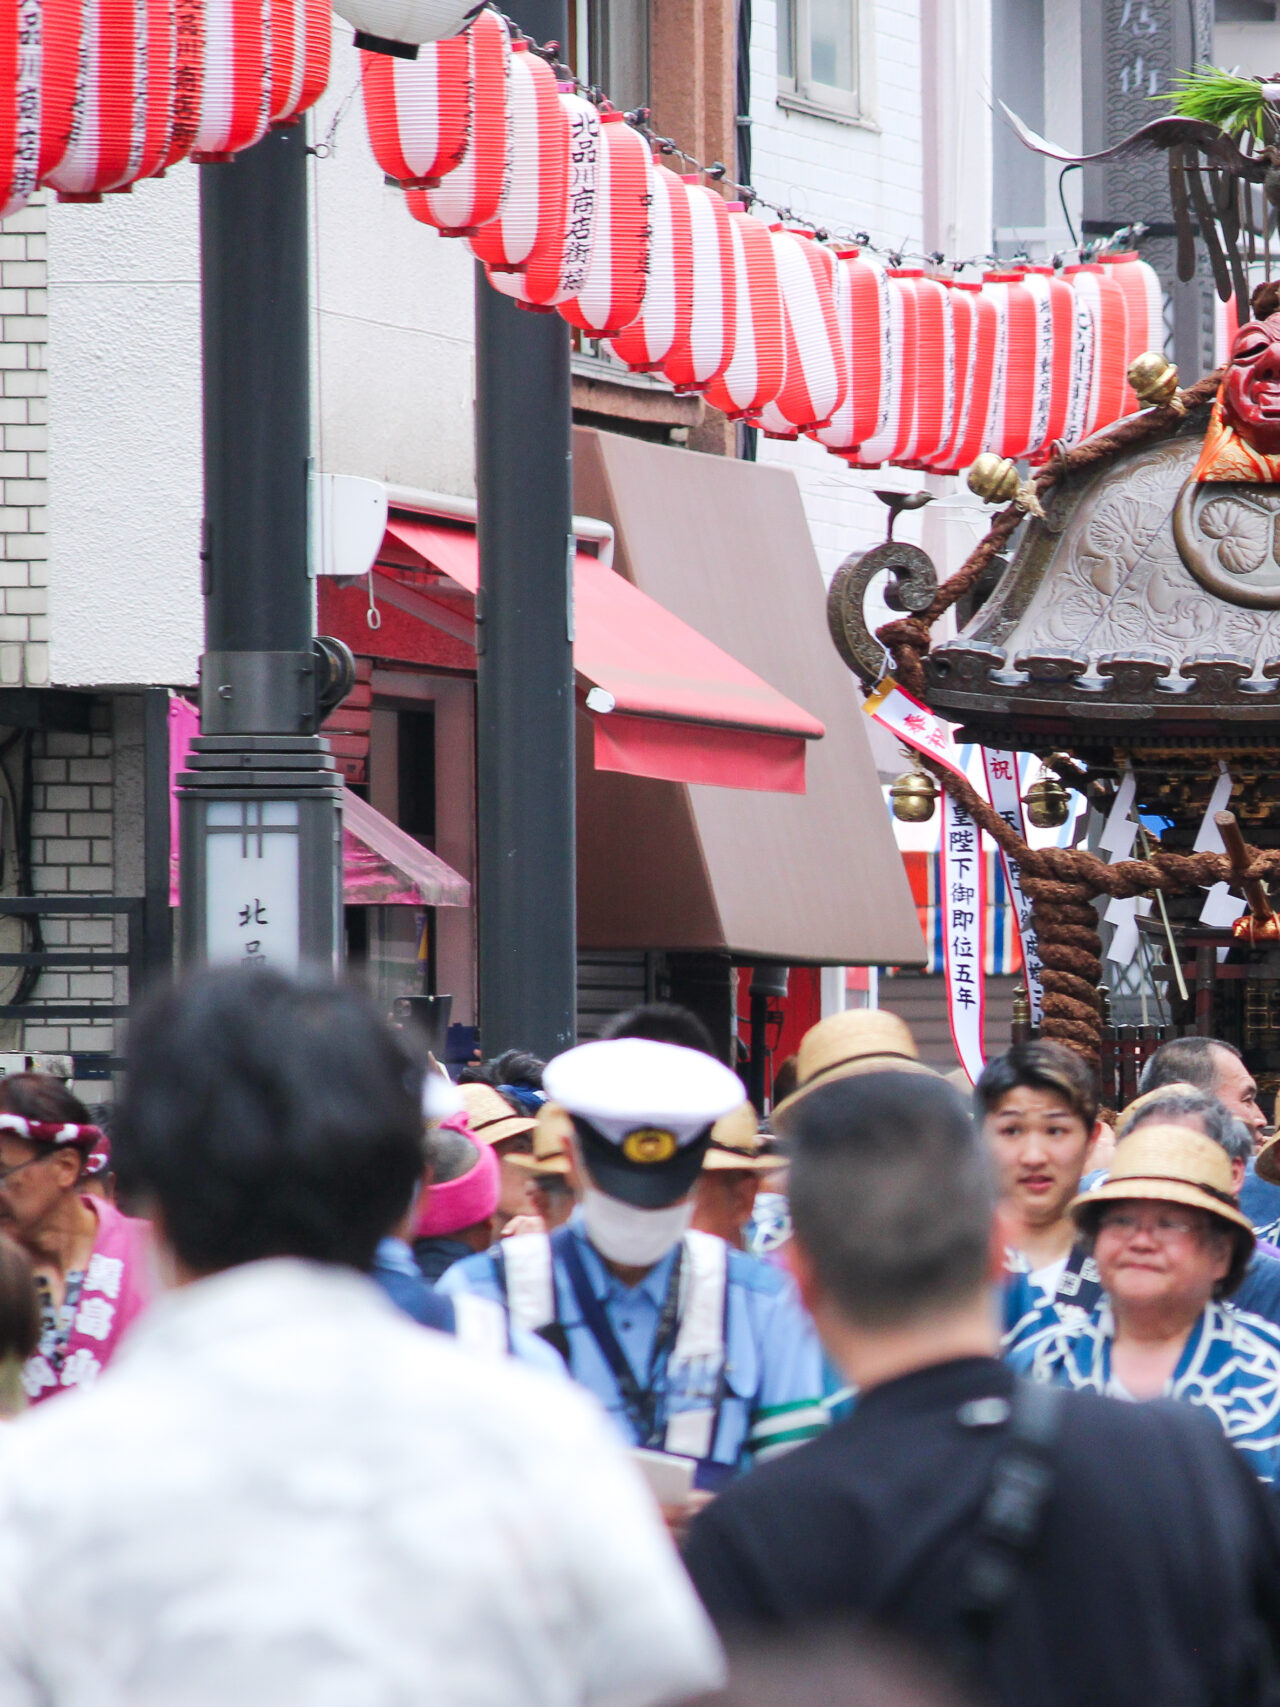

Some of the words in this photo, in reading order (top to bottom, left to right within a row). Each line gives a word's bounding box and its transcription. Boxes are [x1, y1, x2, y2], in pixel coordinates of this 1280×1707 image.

[949, 804, 976, 1010] 皇陛下御即位五年
